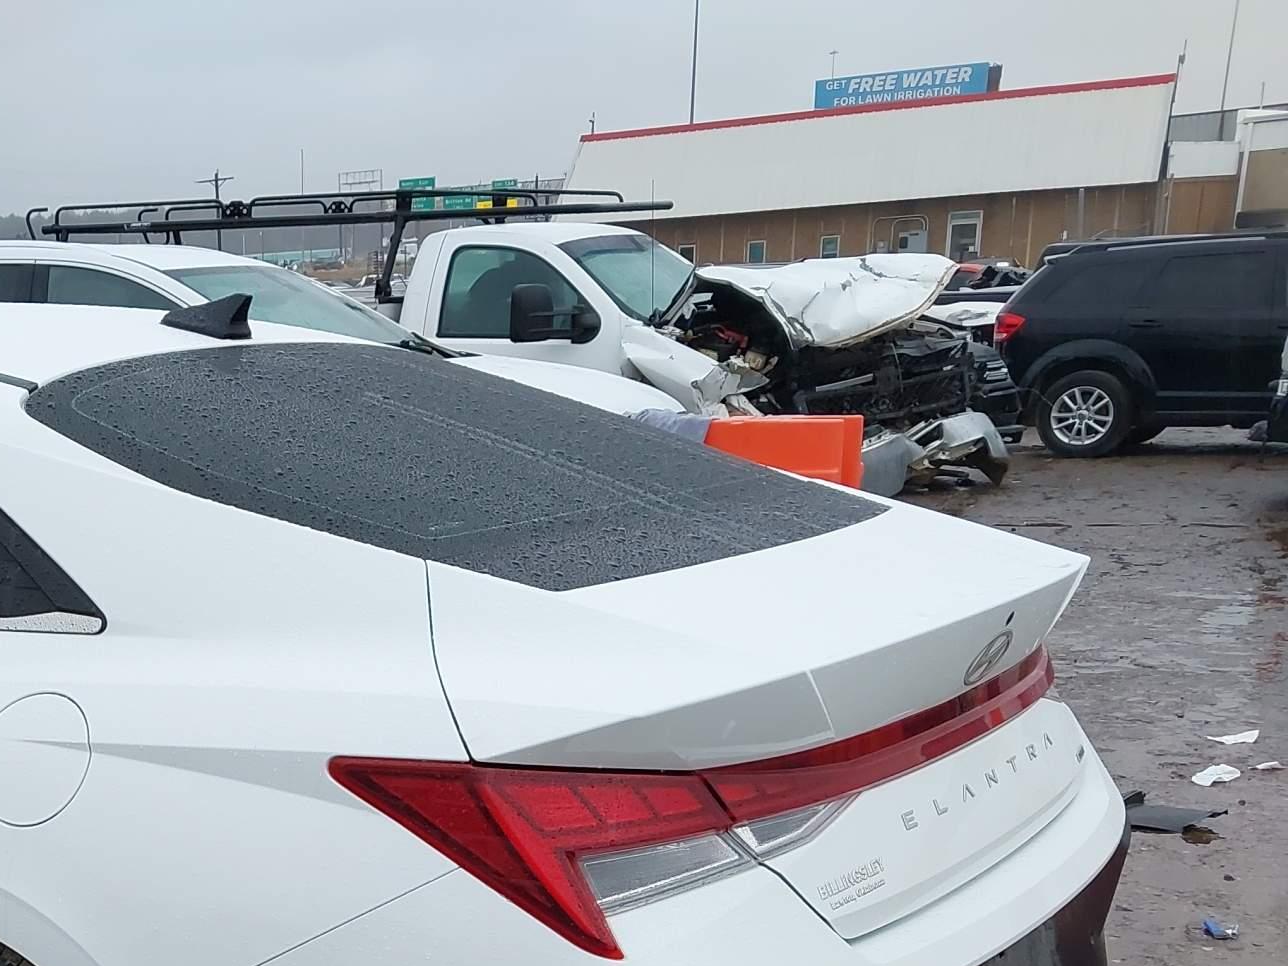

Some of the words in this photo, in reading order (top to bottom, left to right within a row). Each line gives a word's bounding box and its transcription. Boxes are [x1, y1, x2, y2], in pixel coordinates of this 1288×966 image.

[826, 80, 848, 90] GET
[848, 74, 898, 94] FREE
[902, 66, 973, 88] WATER
[833, 97, 856, 107] FOR
[858, 93, 892, 104] LAWN
[894, 85, 961, 101] IRRIGATION
[900, 732, 1054, 831] ELANTRA
[817, 857, 885, 901] BILLINGSLEY
